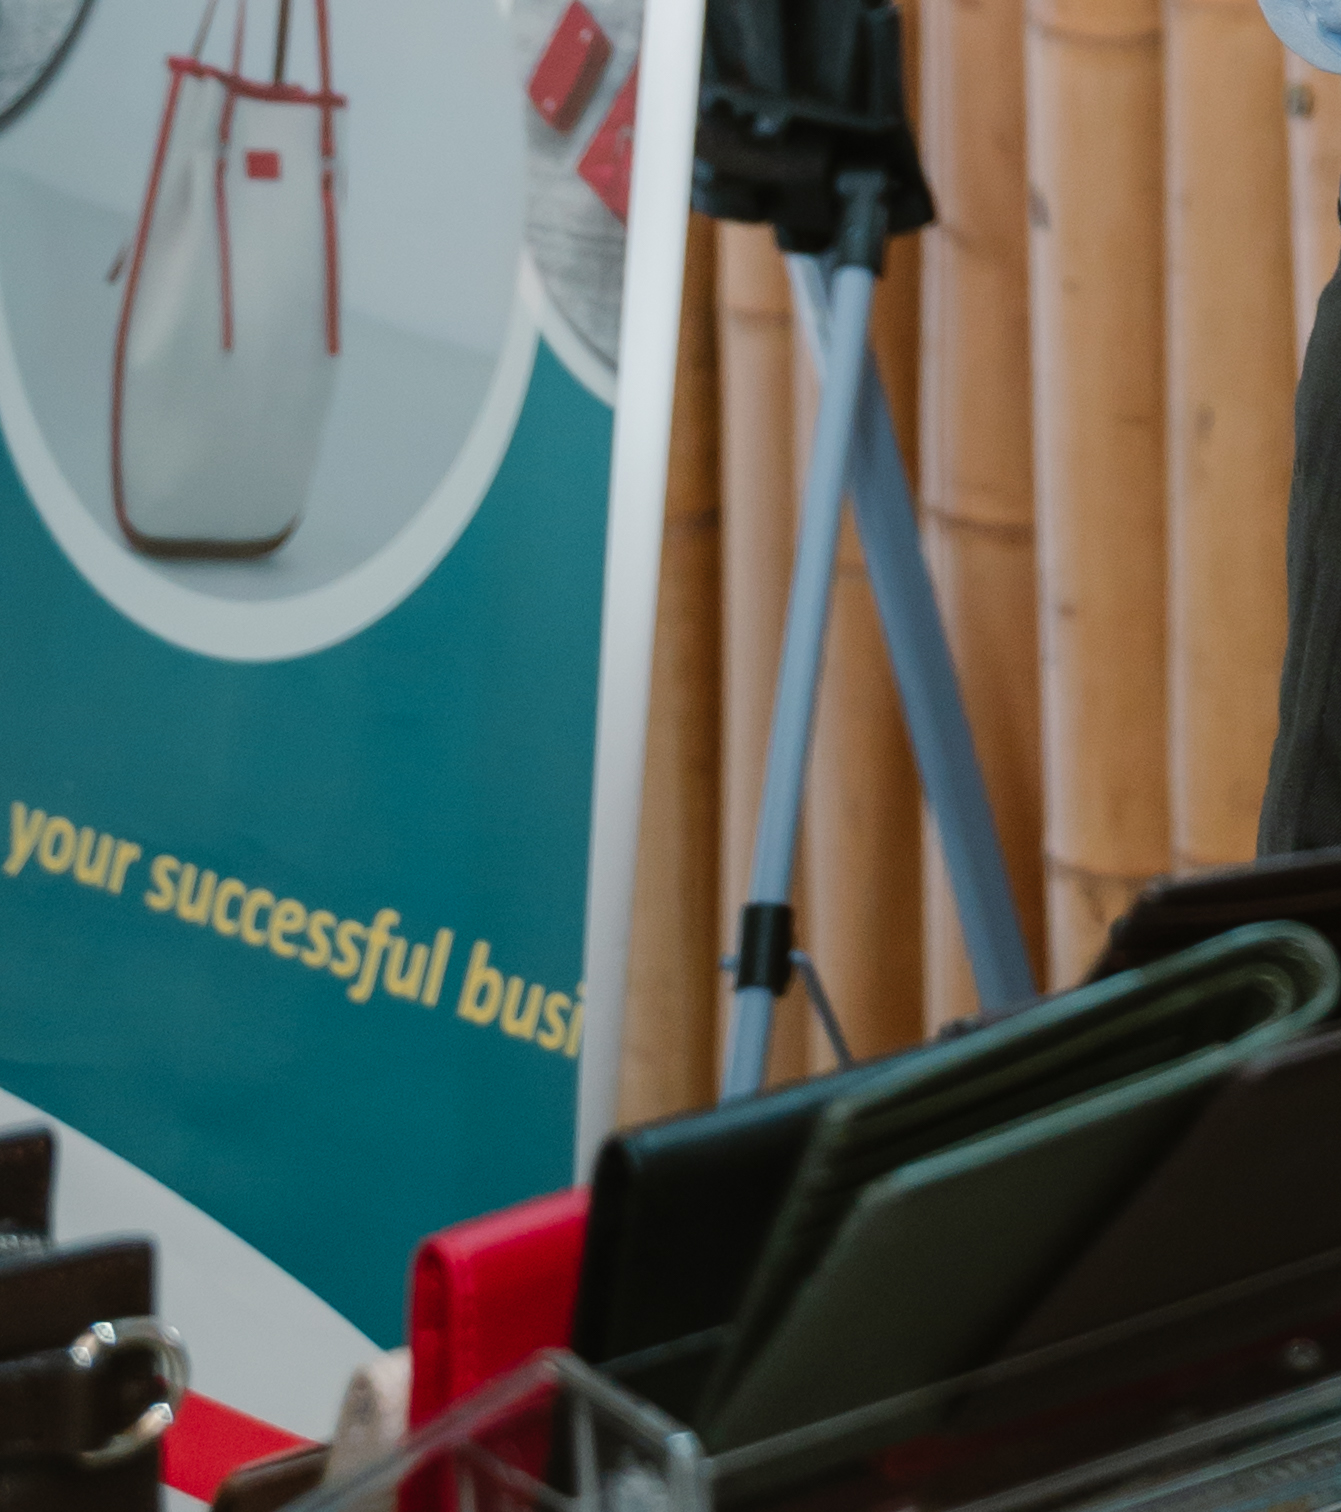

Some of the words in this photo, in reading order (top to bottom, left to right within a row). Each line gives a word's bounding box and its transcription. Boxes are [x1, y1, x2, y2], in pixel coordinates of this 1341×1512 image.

[3, 800, 142, 895] your
[144, 852, 456, 1004] successful
[457, 939, 586, 1058] busi
